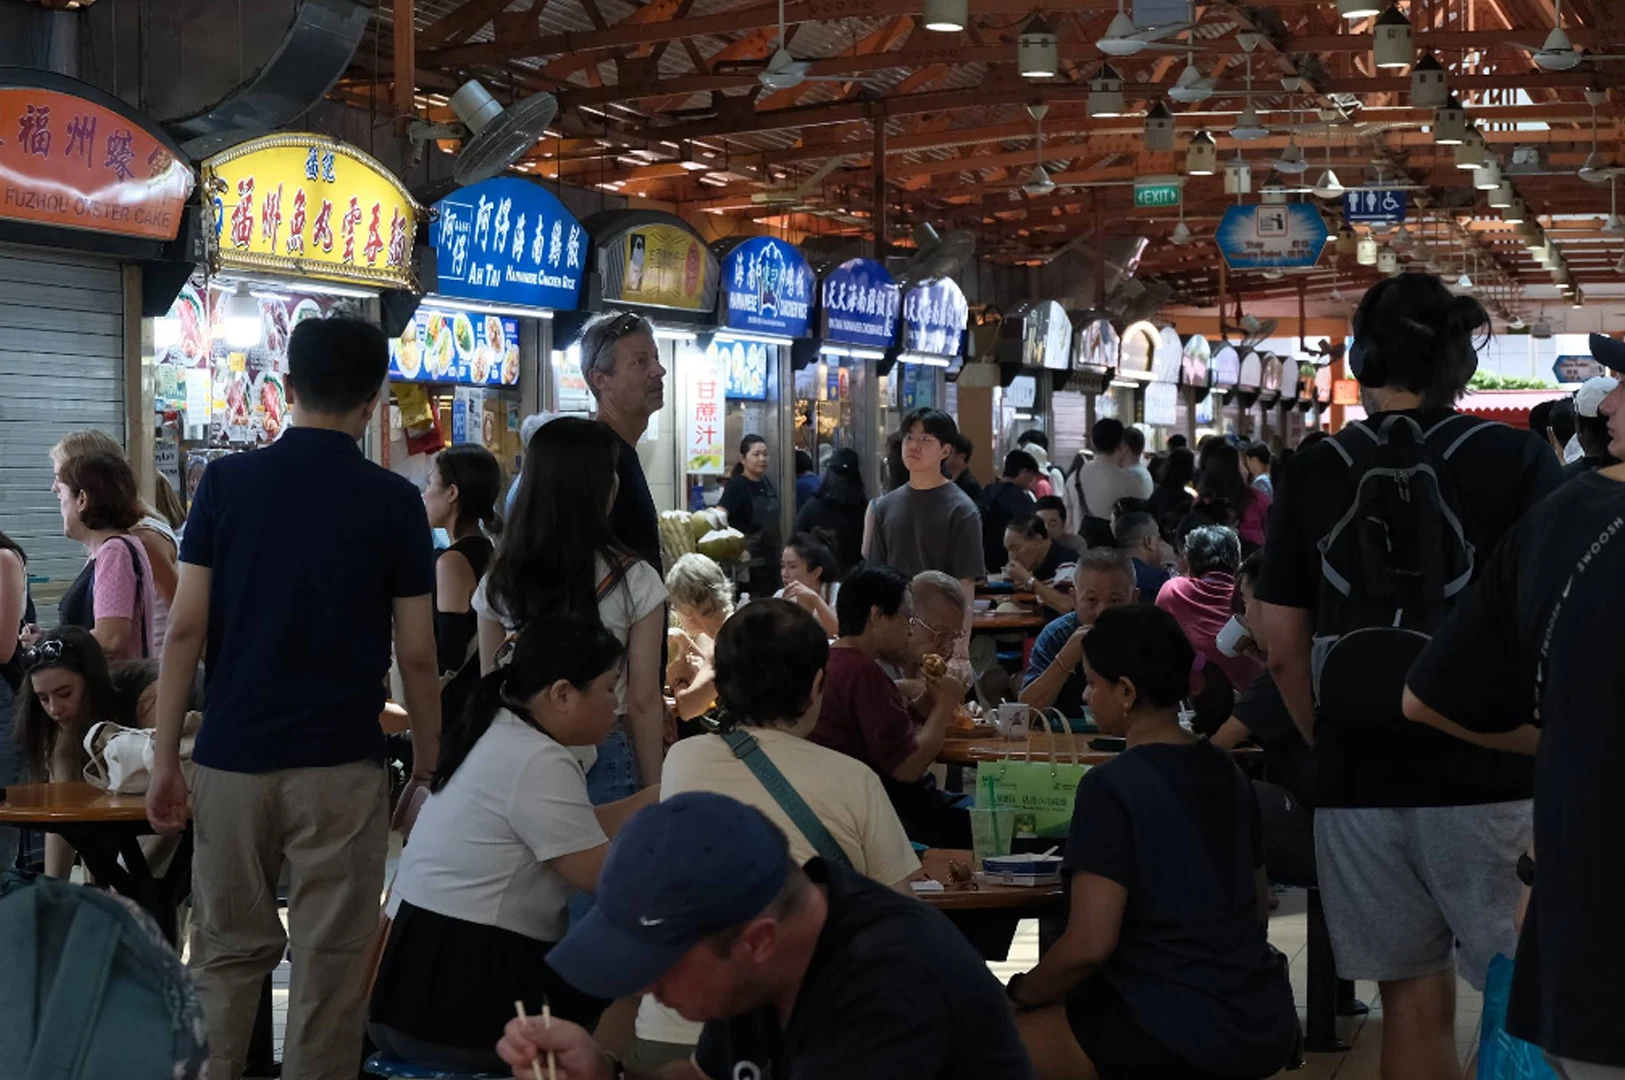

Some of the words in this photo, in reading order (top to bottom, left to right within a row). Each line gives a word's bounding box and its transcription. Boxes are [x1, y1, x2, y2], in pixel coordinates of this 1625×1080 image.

[5, 188, 69, 214] FUZHOU
[73, 196, 130, 221] OYSTER
[134, 209, 171, 229] CAKE
[1143, 190, 1169, 203] EXIT
[695, 379, 718, 445] 甘蔗汁
[1577, 515, 1624, 572] SWOOSH
